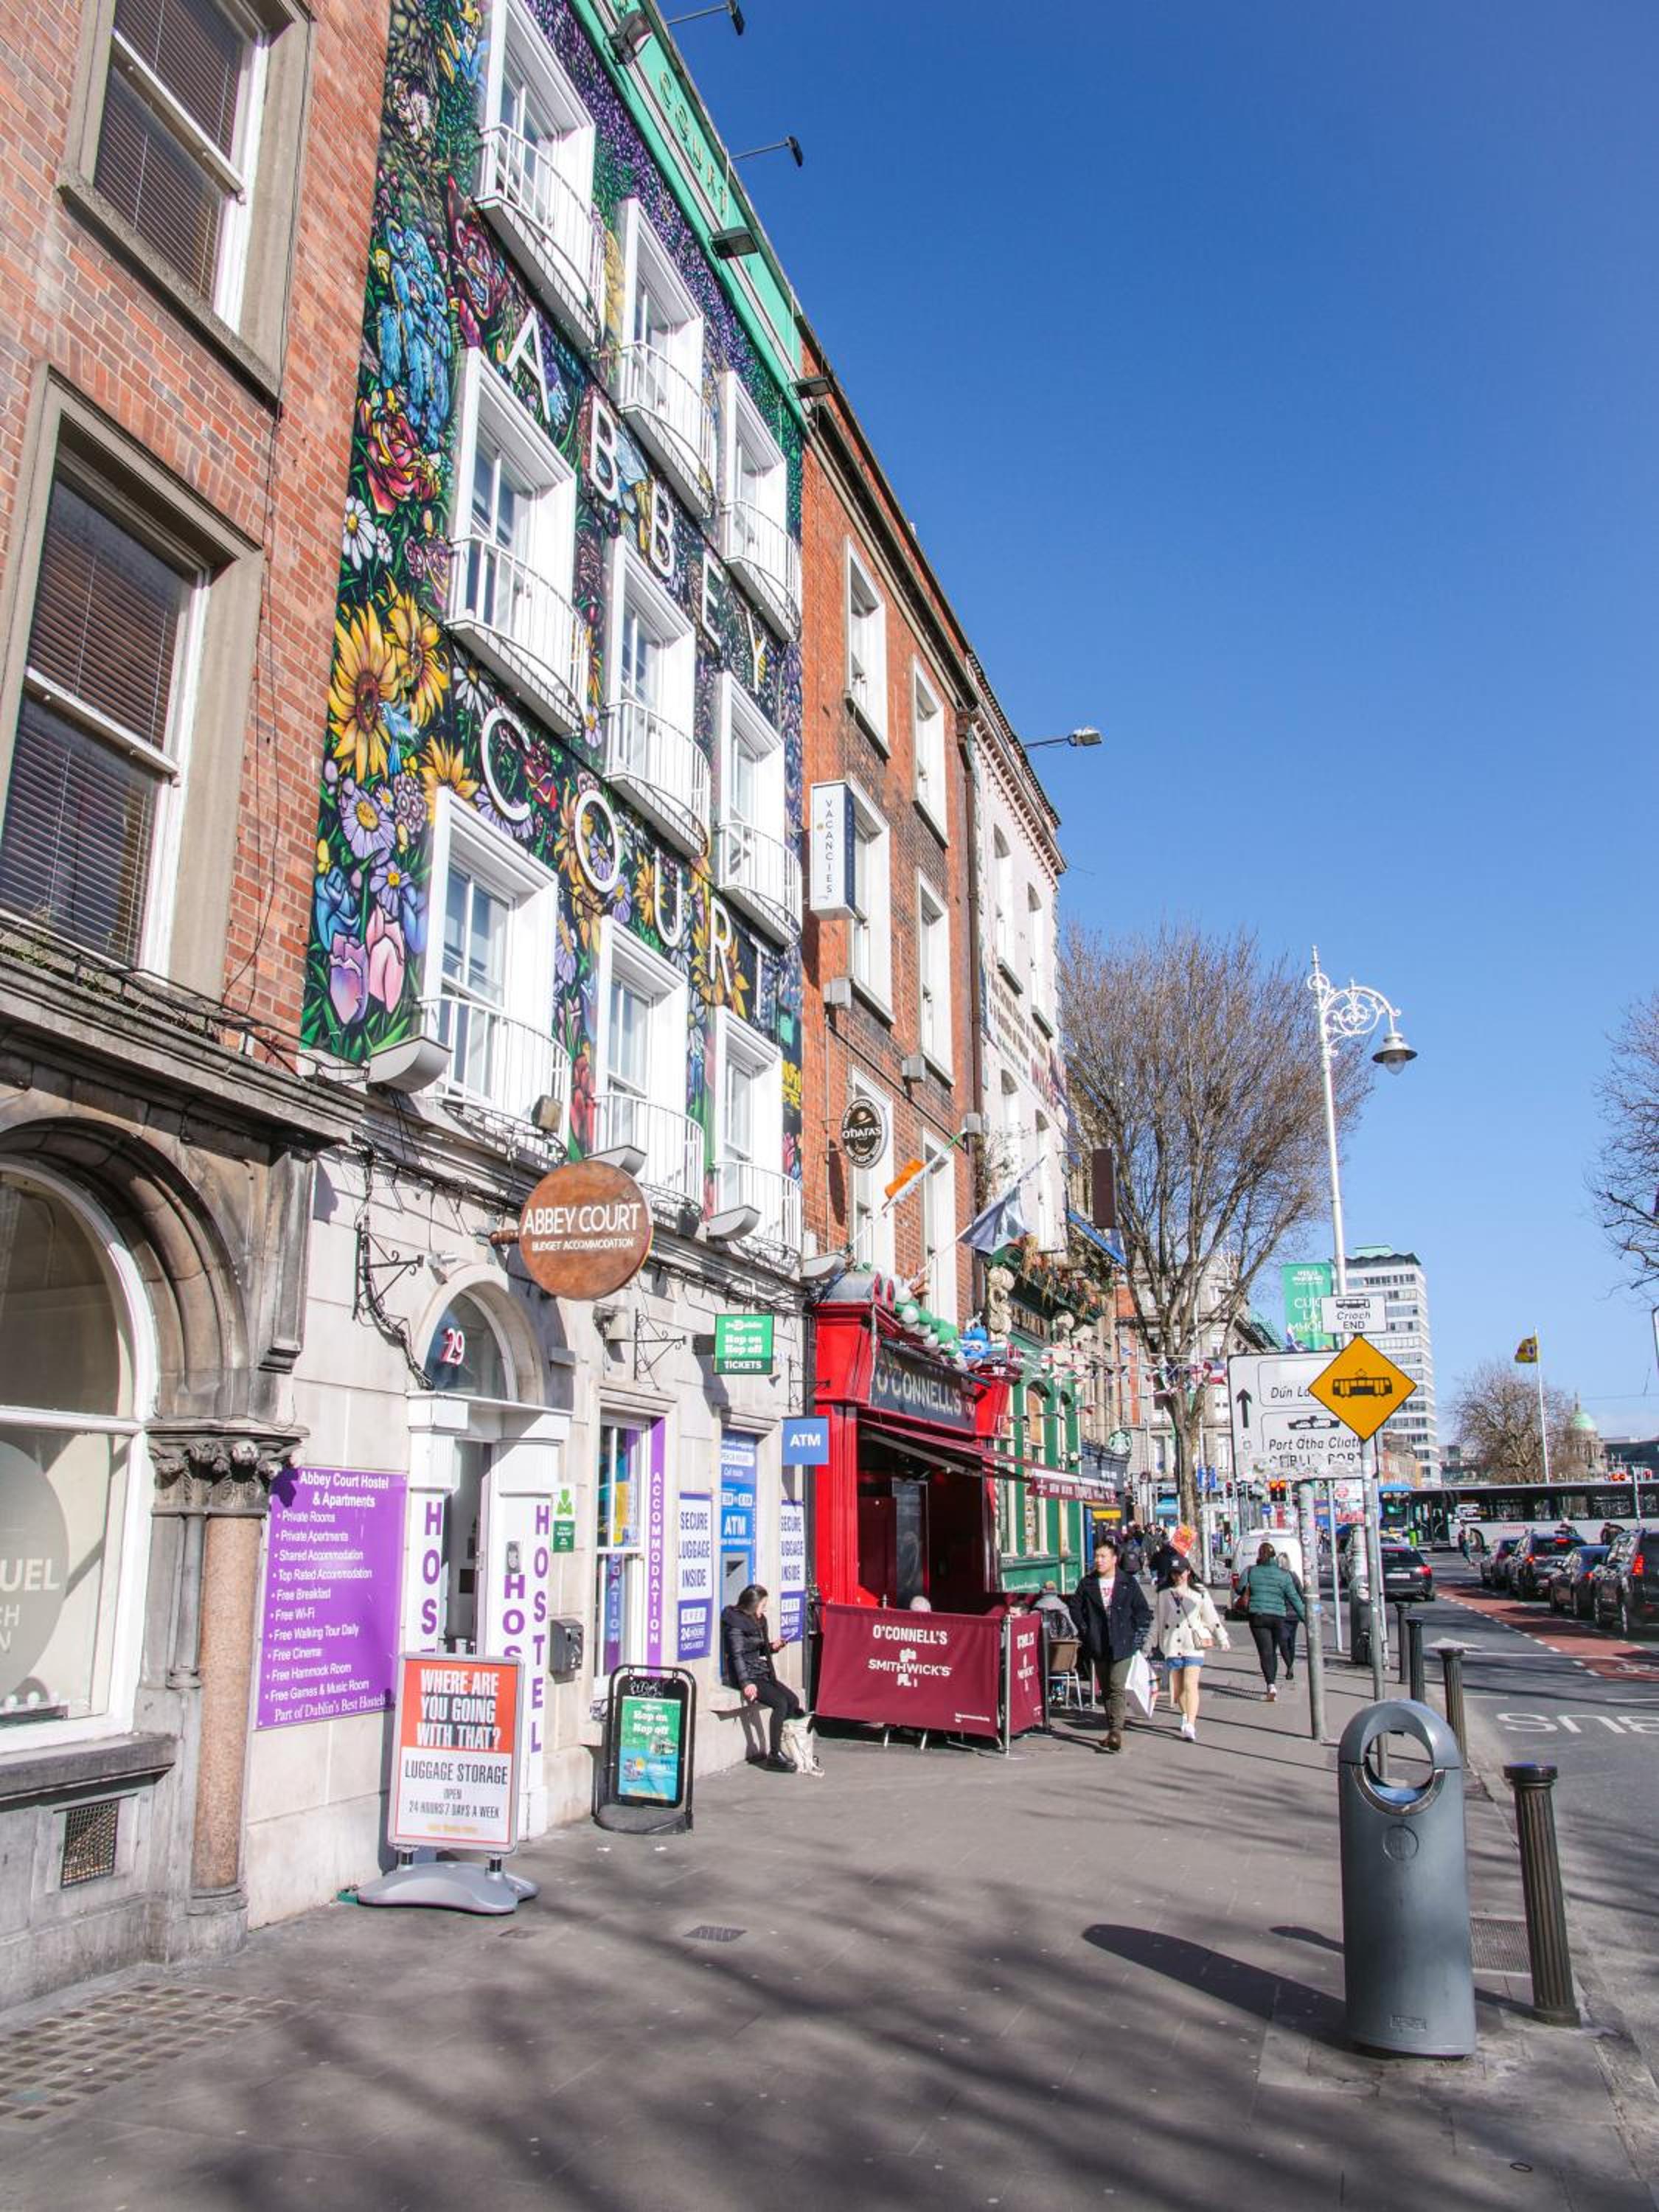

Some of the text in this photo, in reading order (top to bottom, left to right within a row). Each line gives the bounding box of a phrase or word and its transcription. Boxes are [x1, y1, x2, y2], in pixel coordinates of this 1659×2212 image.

[504, 307, 765, 694] ABBEY
[825, 799, 834, 893] VACANCIES
[481, 706, 773, 1020] COURT
[523, 1203, 642, 1235] ABBEY COURT
[532, 1238, 634, 1251] BUDGET ACCOMMODATION
[1343, 1321, 1365, 1329] END
[443, 1327, 465, 1365] 29
[725, 1335, 762, 1346] Hop on
[725, 1344, 763, 1356] Hop off
[724, 1360, 762, 1369] TICKETS
[790, 1434, 821, 1447] ATM
[1269, 1439, 1293, 1451] Port
[299, 1471, 389, 1489] Abbey Court Hostel
[313, 1492, 375, 1509] & Apartments
[282, 1510, 335, 1523] Private Rooms
[679, 1512, 709, 1531] SECURE
[723, 1515, 747, 1536] ATM
[281, 1530, 349, 1543] Private Apartments
[279, 1549, 364, 1561] Shared Accommodation
[650, 1472, 661, 1644] ACCOMMODATION
[678, 1540, 710, 1559] LUGGAGE
[279, 1568, 372, 1582] Top Rated Accommodation
[682, 1568, 706, 1588] INSIDE
[277, 1587, 331, 1601] Free Breakfast
[275, 1607, 315, 1621] Free Wi-Fi
[274, 1624, 360, 1641] Free Walking Tour Daily
[531, 1505, 549, 1753] HOSTEL
[872, 1624, 948, 1645] O'CONNELL'S
[273, 1648, 322, 1660] Free Cinema
[271, 1663, 352, 1681] Free Hammock Room
[868, 1659, 953, 1677] SMITHWICK'S
[271, 1690, 288, 1702] Free
[291, 1686, 318, 1699] Games
[327, 1681, 348, 1694] Music
[349, 1679, 369, 1691] Room
[420, 1669, 499, 1696] WHERE ARE
[274, 1708, 293, 1722] Part
[294, 1704, 304, 1719] of
[305, 1700, 340, 1718] Dublin's
[341, 1697, 358, 1711] Best
[421, 1695, 496, 1723] YOU GOING
[633, 1709, 654, 1722] Hop
[417, 1722, 501, 1750] WITH THAT?
[633, 1722, 669, 1736] Hop off
[405, 1759, 508, 1785] LUGGAGE STORAGE
[443, 1788, 462, 1800] OPEN
[408, 1800, 418, 1813] 24
[452, 1803, 470, 1817] DAYS
[479, 1805, 499, 1818] WEEK
